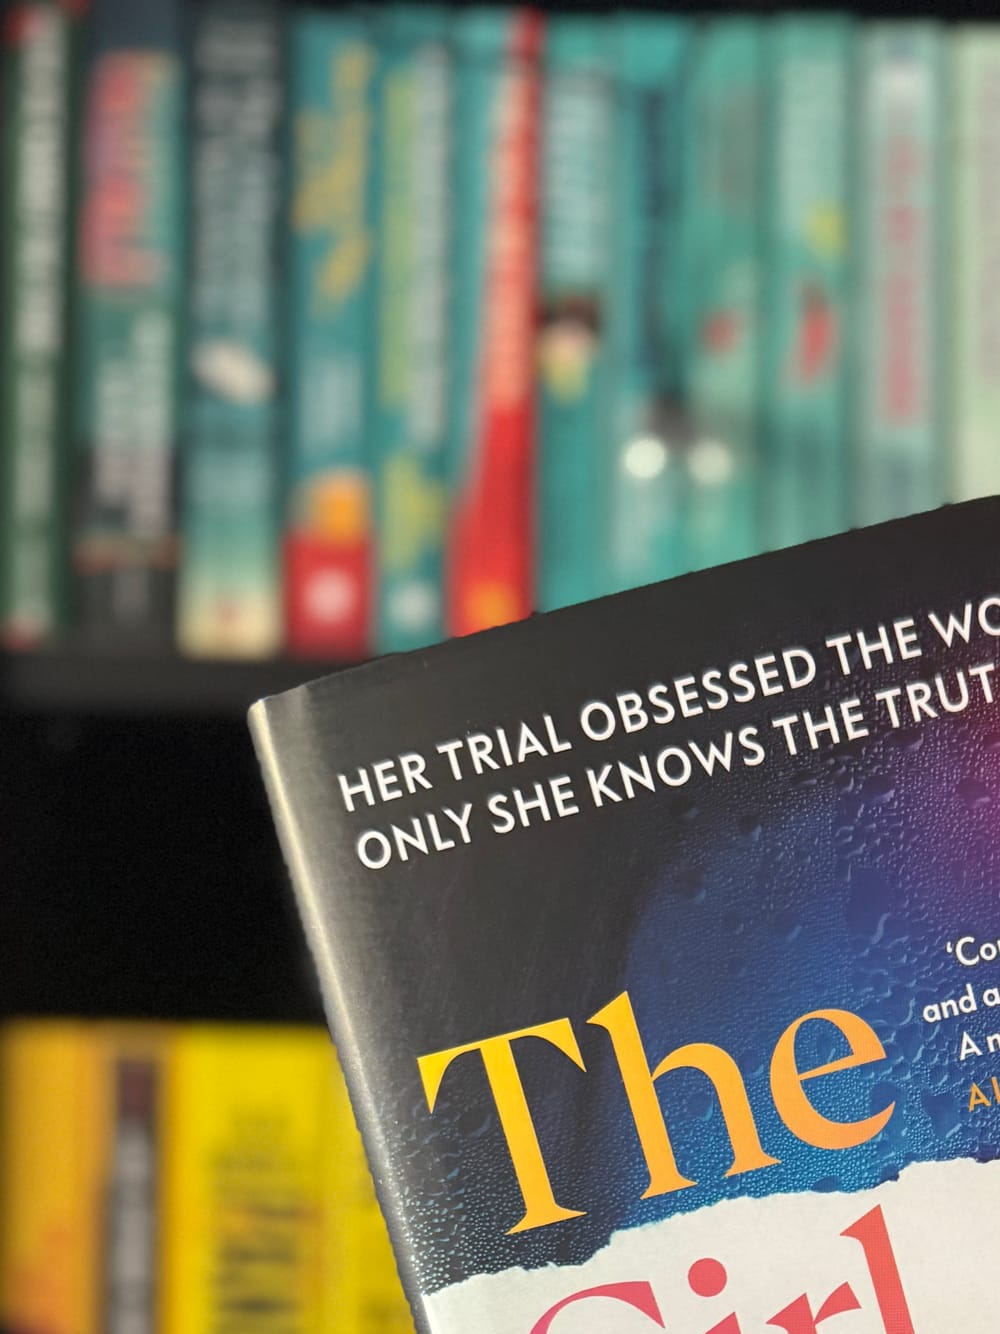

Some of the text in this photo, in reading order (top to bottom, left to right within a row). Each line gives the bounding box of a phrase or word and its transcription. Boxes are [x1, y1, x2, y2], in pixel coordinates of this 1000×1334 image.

[338, 747, 431, 813] HER
[437, 711, 573, 783] TRIAL
[578, 647, 818, 744] OBSESSED
[825, 616, 924, 680] THE
[355, 802, 474, 870] ONLY
[488, 775, 580, 835] SHE
[586, 725, 767, 808] KNOWS
[772, 700, 871, 760] THE
[922, 984, 978, 1024] and
[982, 987, 1000, 1008] a
[958, 1030, 981, 1062] A
[416, 990, 896, 1236] The
